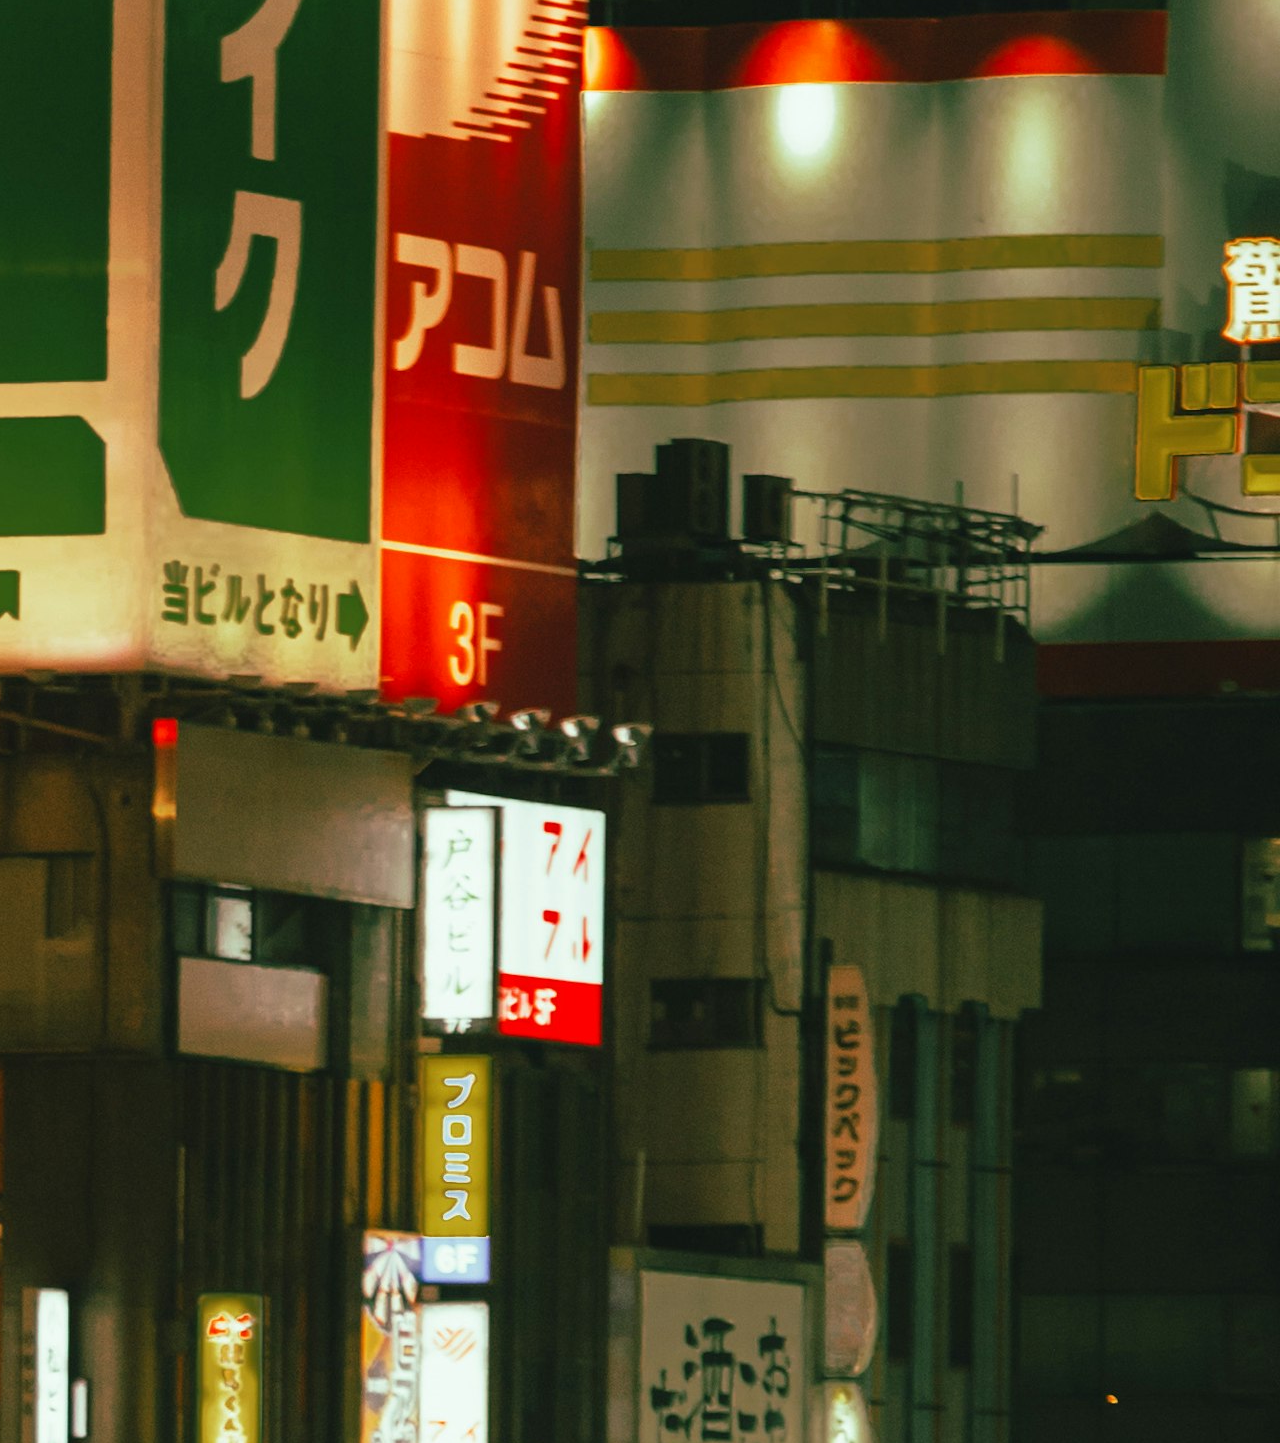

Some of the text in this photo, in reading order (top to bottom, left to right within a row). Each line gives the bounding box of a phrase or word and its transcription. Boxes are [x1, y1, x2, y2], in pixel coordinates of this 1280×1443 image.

[392, 233, 567, 391] アコム
[162, 560, 330, 641] 当ビルとなり
[449, 600, 505, 687] 3F
[441, 1073, 476, 1222] プロミス
